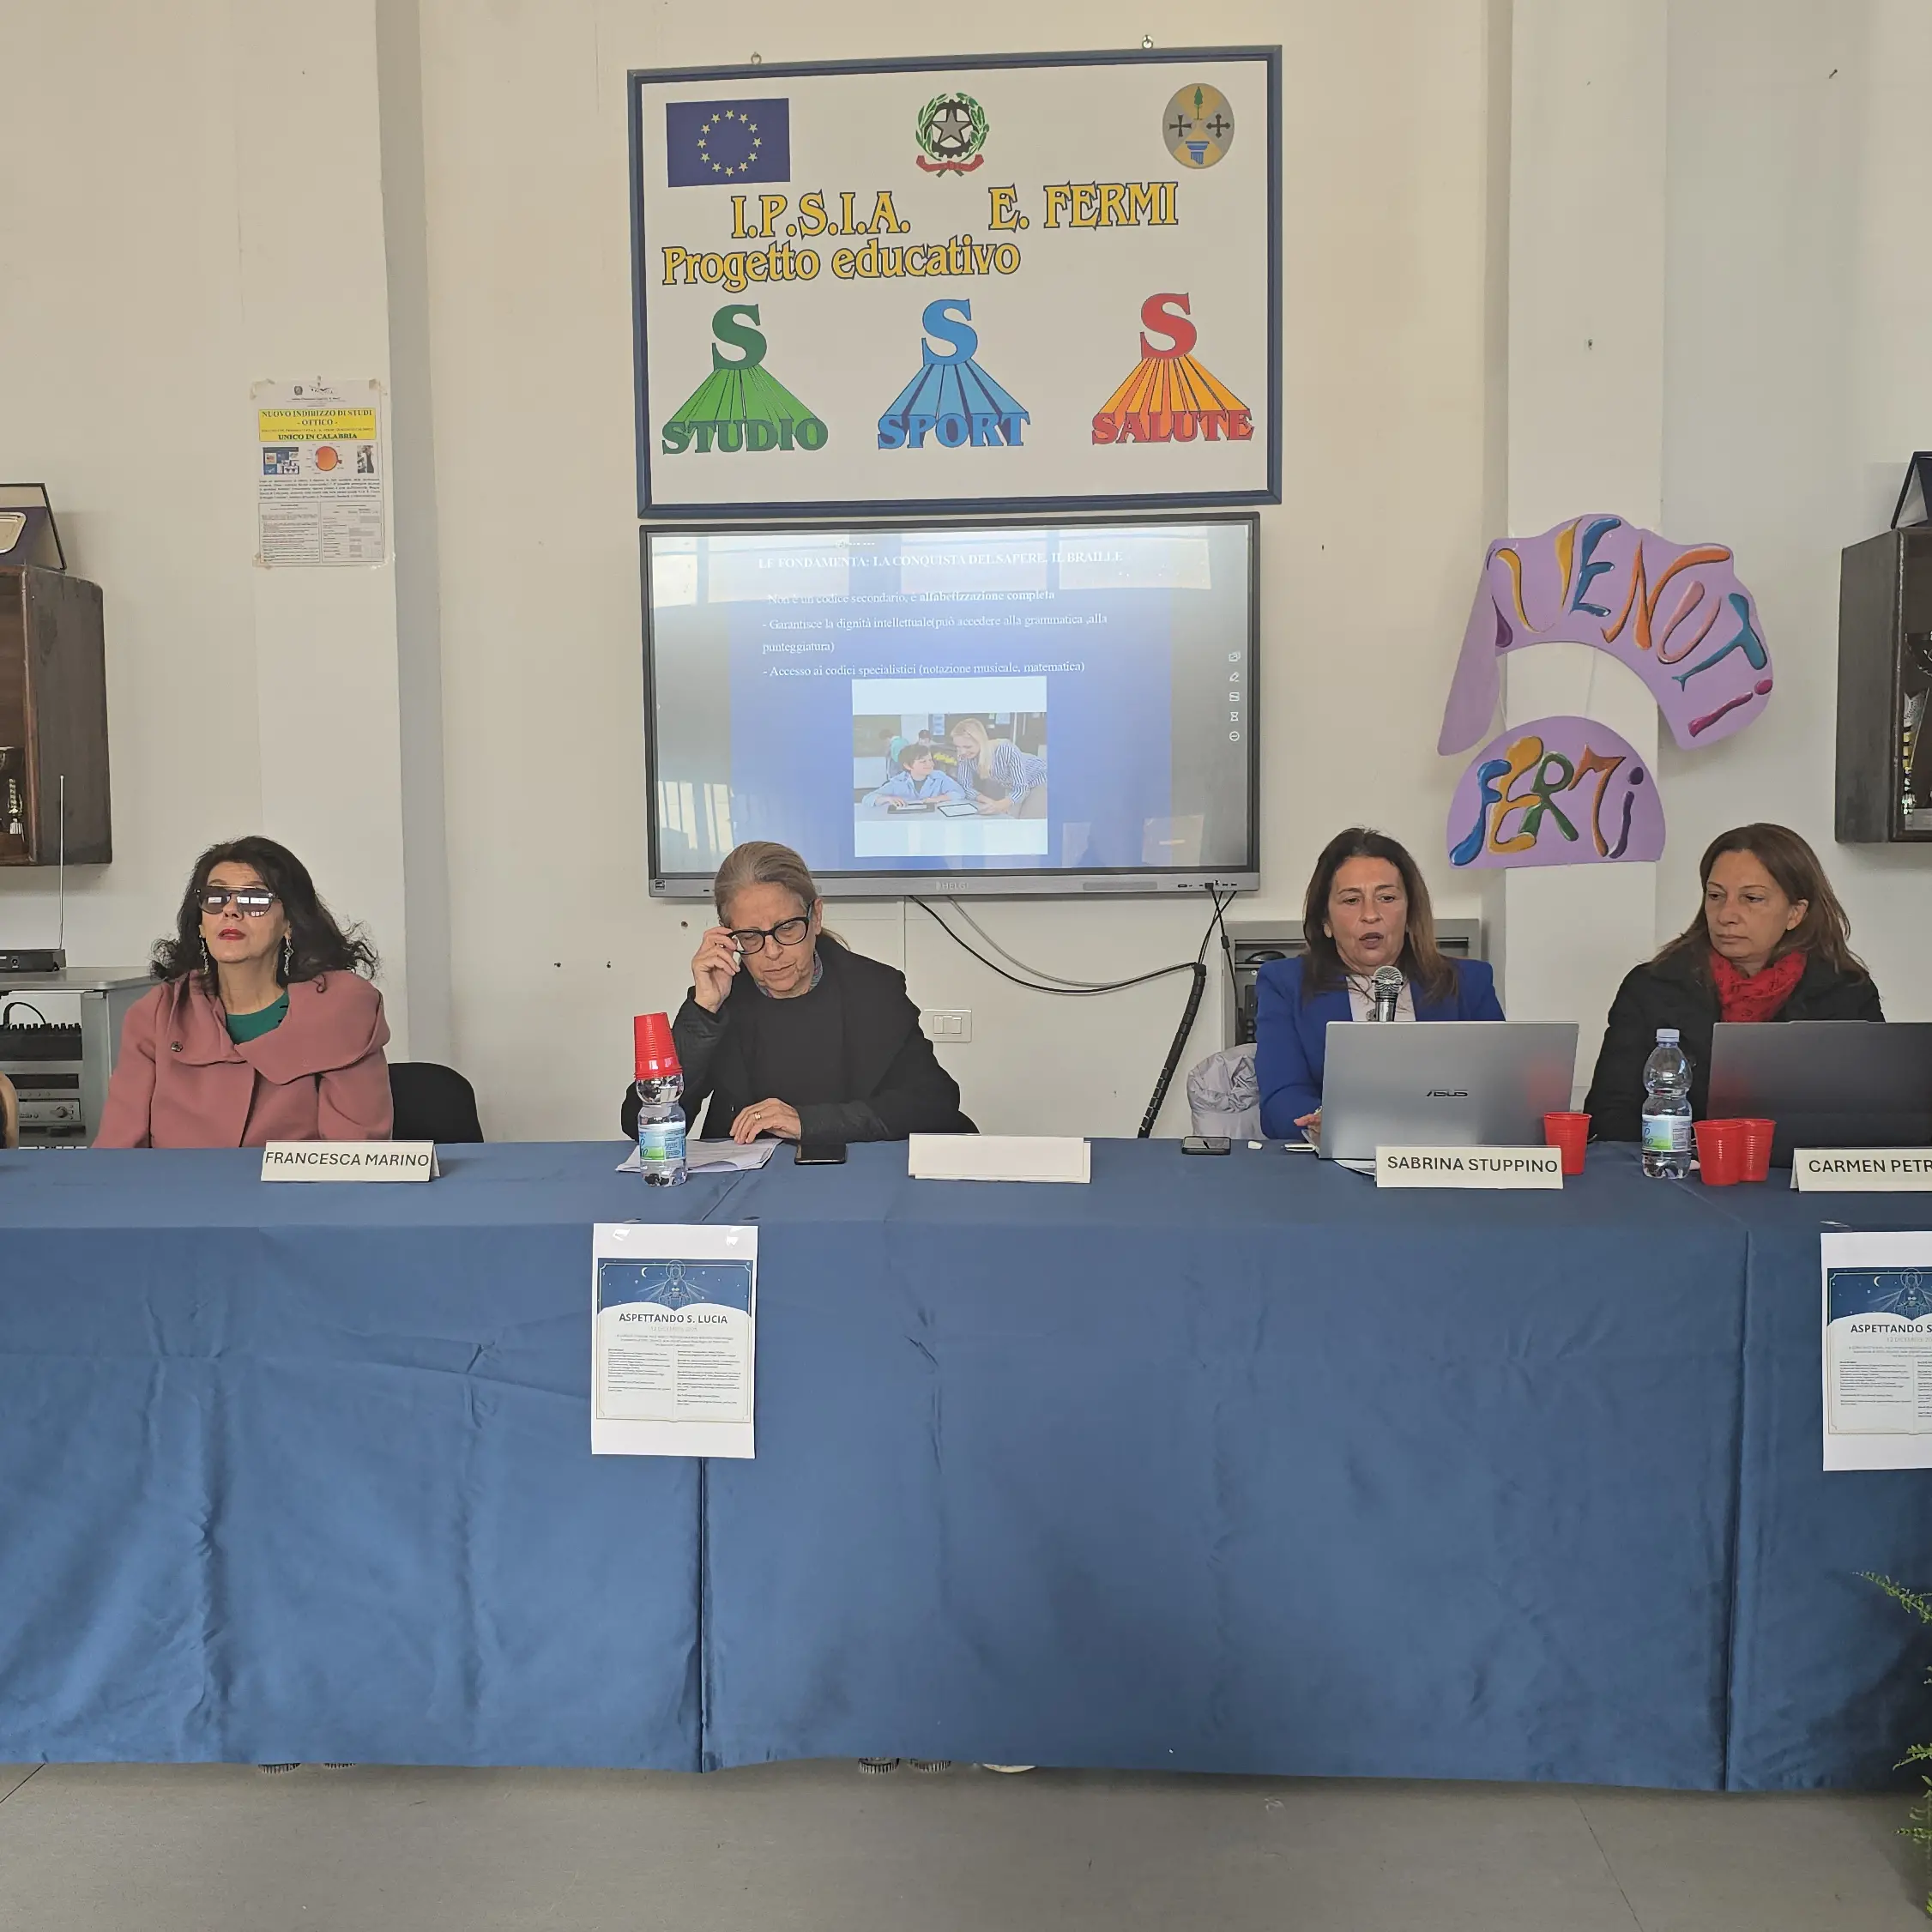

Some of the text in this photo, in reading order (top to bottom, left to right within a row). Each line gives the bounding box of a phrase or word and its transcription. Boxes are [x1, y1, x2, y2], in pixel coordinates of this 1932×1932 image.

[731, 182, 1179, 238] I.P.S.I.A. E. FERMI
[662, 234, 1020, 293] Progetto educativo
[921, 298, 979, 365] S
[1140, 292, 1198, 359] S
[711, 303, 767, 370] S
[878, 411, 1030, 450] SPORT
[1092, 409, 1255, 445] SALUTE
[662, 418, 828, 455] STUDIO
[778, 556, 870, 569] FONDAMENTA:
[873, 555, 891, 567] LA
[893, 553, 966, 566] CONQUISTA
[1052, 552, 1064, 564] IL
[1067, 551, 1124, 563] BRAILLE
[817, 594, 849, 604] codice
[920, 590, 1005, 602] alfabetizzazione
[1006, 589, 1056, 602] completa
[769, 618, 823, 630] Garantisce
[825, 618, 834, 628] la
[836, 617, 872, 631] dignità
[958, 615, 1001, 627] accedere
[1004, 614, 1022, 626] alla
[1024, 613, 1084, 628] grammatica
[762, 641, 836, 655] punteggiatura)
[770, 666, 812, 677] Accesso
[814, 665, 823, 676] ai
[825, 665, 856, 676] codici
[858, 663, 916, 677] specialistici
[919, 662, 971, 676] (notazione
[974, 661, 1021, 674] musicale,
[1023, 660, 1085, 673] matematica)
[265, 1151, 429, 1167] FRANCESCA MARINO
[1387, 1156, 1558, 1173] SABRINA STUPPINO
[1808, 1160, 1887, 1173] CARMEN
[619, 1313, 728, 1324] ASPETTANDO S. LUCIA
[1850, 1324, 1923, 1333] ASPETTANDO
